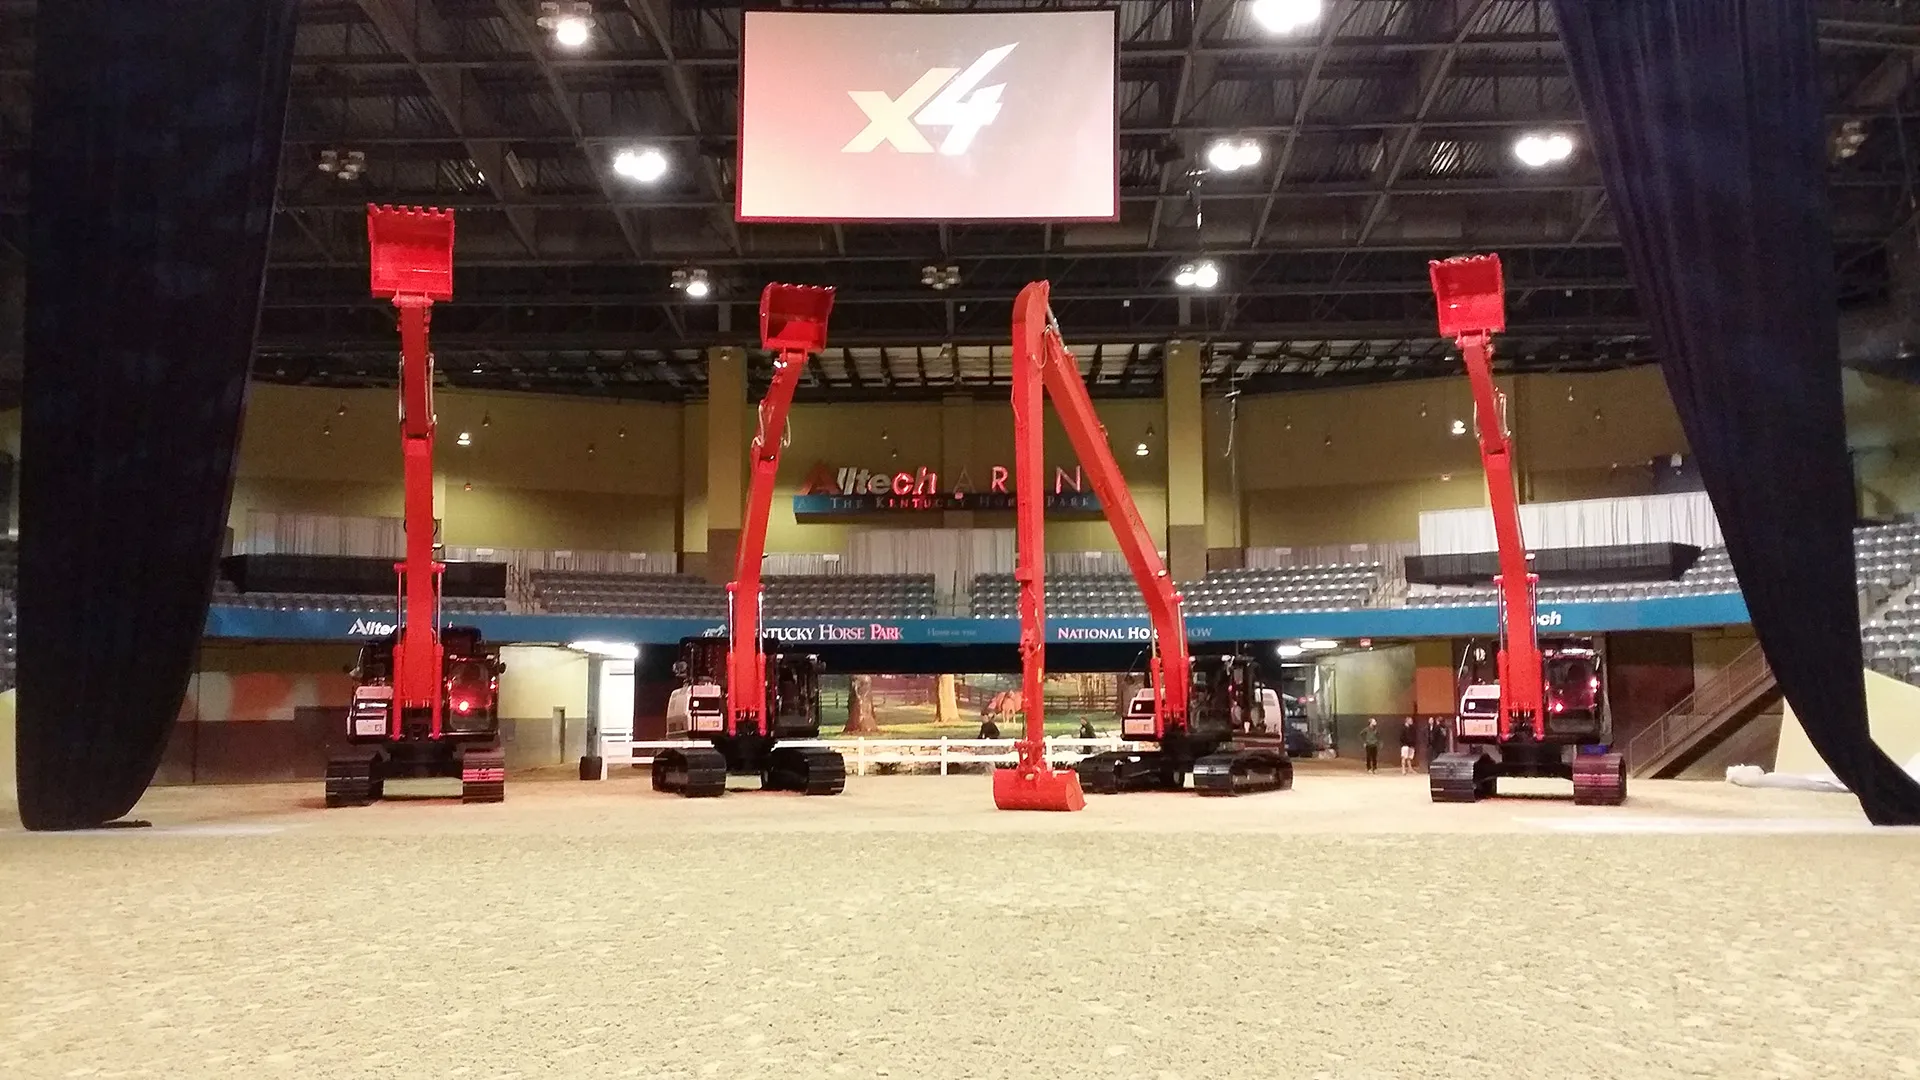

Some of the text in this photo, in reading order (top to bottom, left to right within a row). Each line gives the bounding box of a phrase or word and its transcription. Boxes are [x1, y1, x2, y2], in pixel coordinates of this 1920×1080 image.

[798, 462, 937, 496] Alltech
[755, 622, 904, 641] NTUCKY HORSE PARK
[1058, 627, 1125, 640] NATIONAL
